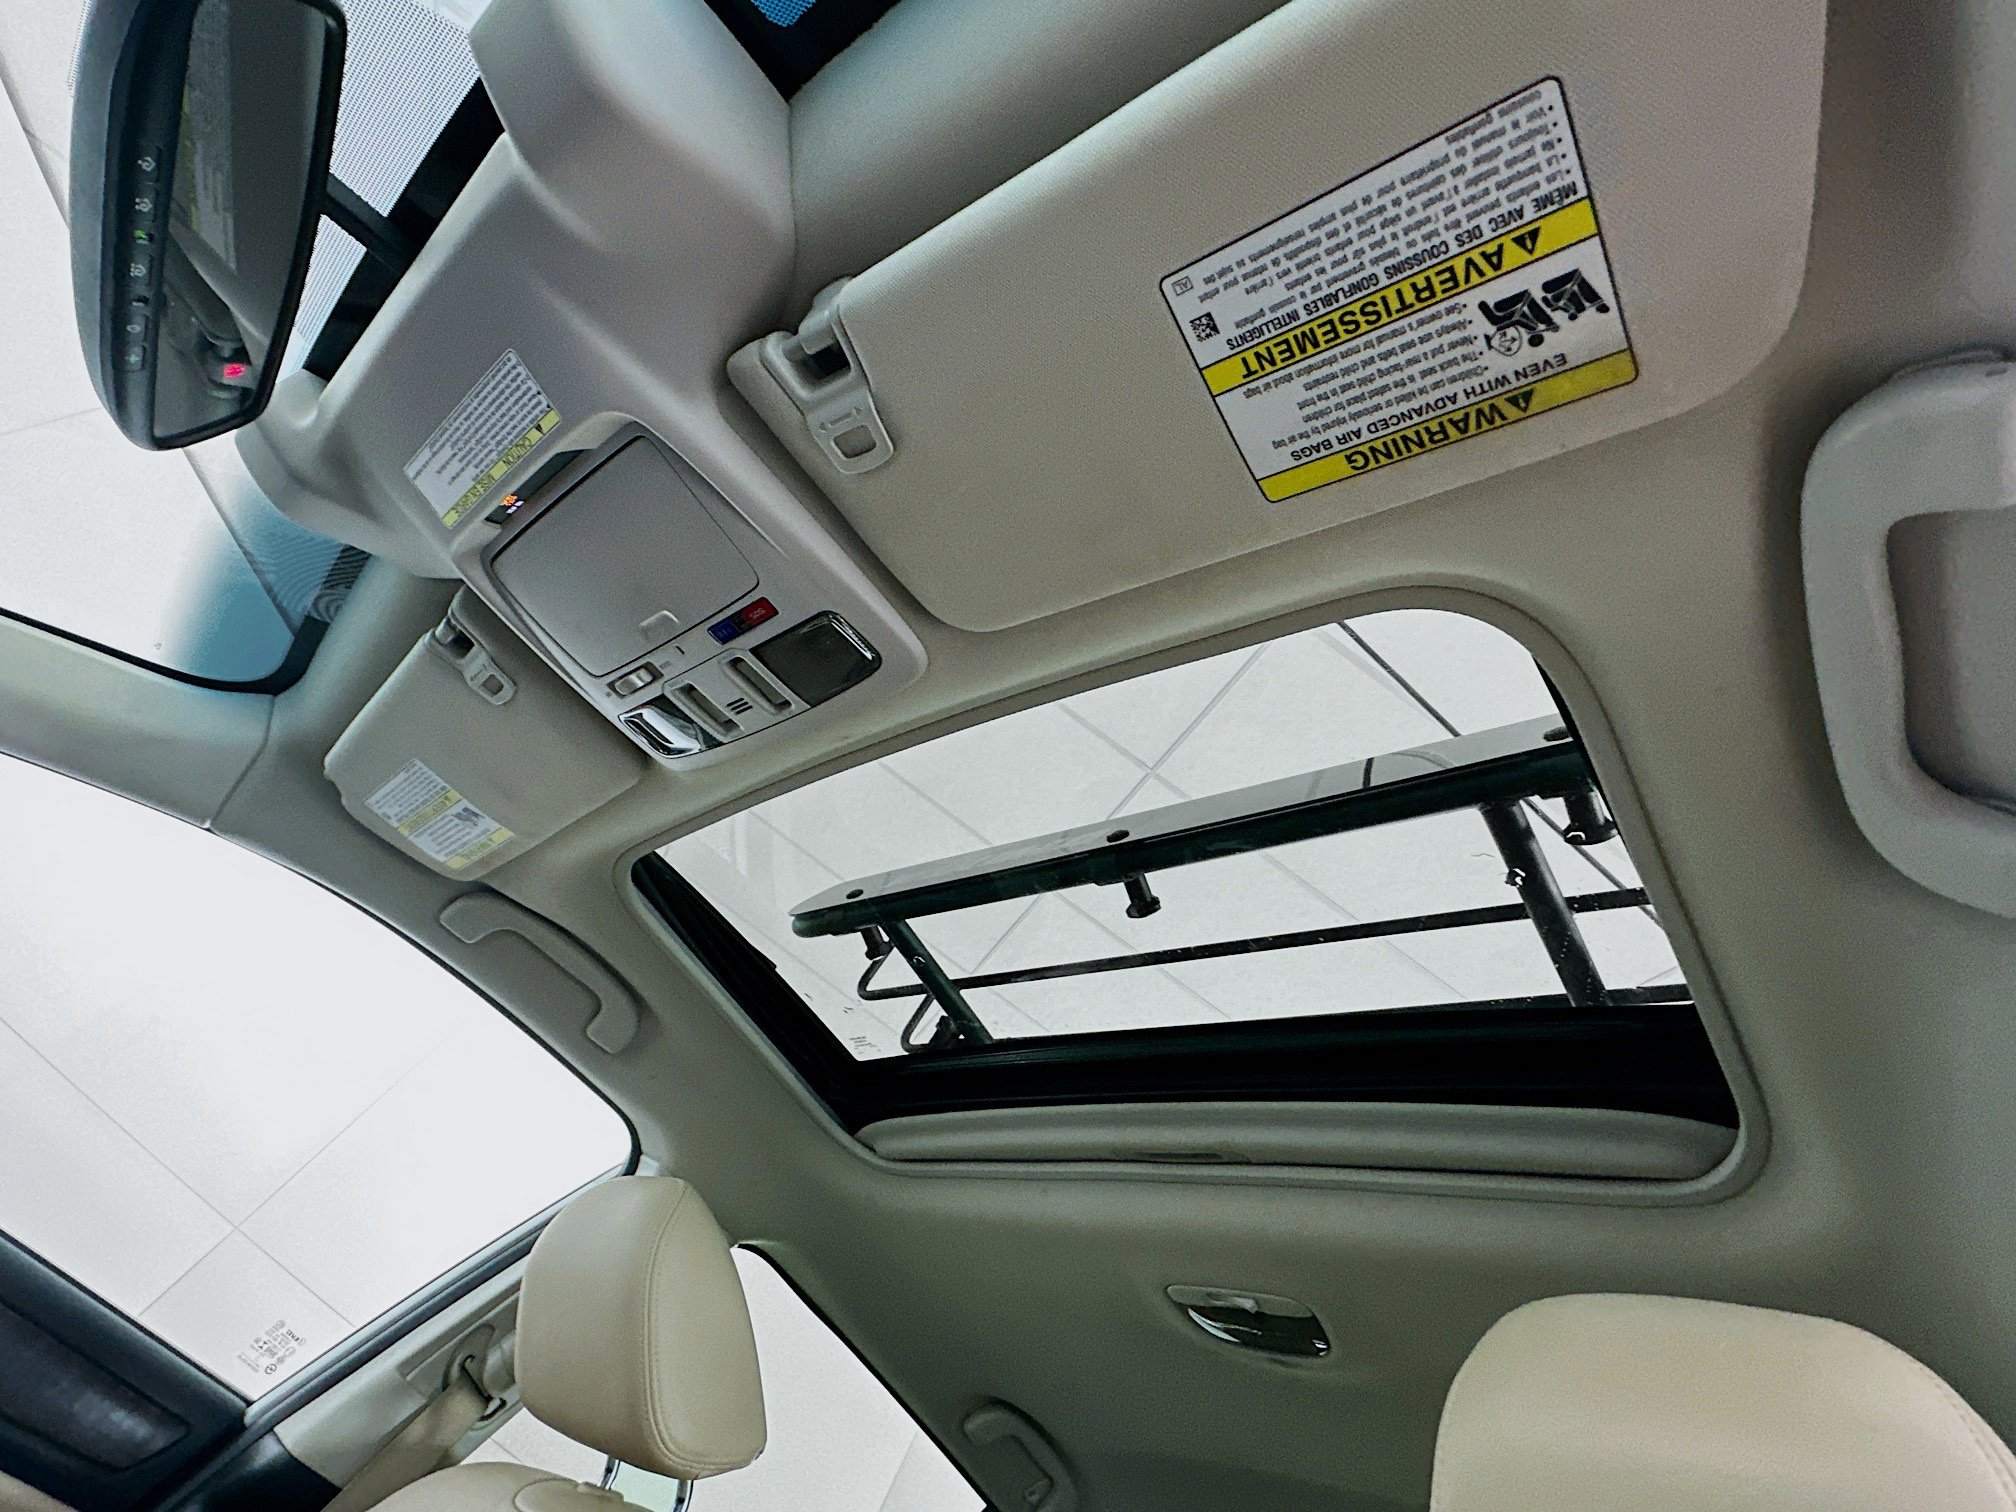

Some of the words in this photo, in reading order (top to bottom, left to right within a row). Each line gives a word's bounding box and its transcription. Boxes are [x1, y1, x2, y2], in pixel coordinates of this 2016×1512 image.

[1530, 180, 1579, 217] MÊME
[1486, 204, 1526, 233] AVEC
[1453, 223, 1484, 249] DES
[1382, 239, 1450, 280] COUSSINS
[1302, 271, 1380, 316] GONFLABLES
[1234, 241, 1510, 379] AVERTISSEMENT
[1443, 302, 1462, 319] See
[1224, 308, 1300, 351] INTELLIGENTS
[1406, 309, 1444, 334] owner's
[1434, 317, 1468, 341] Always
[1373, 324, 1408, 347] manual
[1416, 331, 1435, 347] use
[1445, 334, 1473, 353] Never
[1337, 343, 1362, 362] more
[1360, 337, 1375, 353] for
[1397, 338, 1418, 355] seat
[1428, 344, 1446, 360] put
[1358, 354, 1377, 370] and
[1375, 346, 1398, 364] belts
[1421, 351, 1430, 363] a
[1460, 349, 1479, 365] The
[1293, 352, 1339, 380] information
[1337, 361, 1360, 378] child
[1376, 354, 1422, 380] rear-facing
[1418, 365, 1438, 381] seat
[1437, 356, 1460, 374] back
[1512, 351, 1568, 382] EVEN
[1271, 371, 1295, 389] about
[1301, 369, 1340, 393] restraints
[1355, 372, 1377, 388] child
[1390, 376, 1408, 391] the
[1406, 373, 1416, 385] is
[1445, 364, 1485, 387] Children
[1241, 384, 1262, 401] bags
[1260, 379, 1274, 393] air
[1328, 386, 1339, 399] in
[1337, 380, 1357, 395] seat
[1366, 382, 1393, 400] safest
[1416, 385, 1429, 398] be
[1428, 378, 1447, 394] can
[1462, 372, 1511, 400] WITH
[1295, 395, 1317, 411] front
[1315, 390, 1330, 404] the
[1344, 392, 1368, 408] place
[1382, 398, 1394, 410] or
[1393, 389, 1417, 406] killed
[1300, 405, 1333, 425] children
[1332, 400, 1346, 413] for
[1346, 401, 1384, 423] seriously
[1364, 391, 1460, 435] ADVANCED
[1309, 425, 1321, 437] by
[1319, 415, 1348, 433] injured
[1271, 437, 1288, 451] bag
[1285, 434, 1298, 446] air
[1296, 429, 1311, 442] the
[1333, 426, 1364, 446] AIR
[1343, 398, 1508, 473] WARNING
[499, 433, 532, 468] CAUTION
[1289, 437, 1333, 462] BAGS
